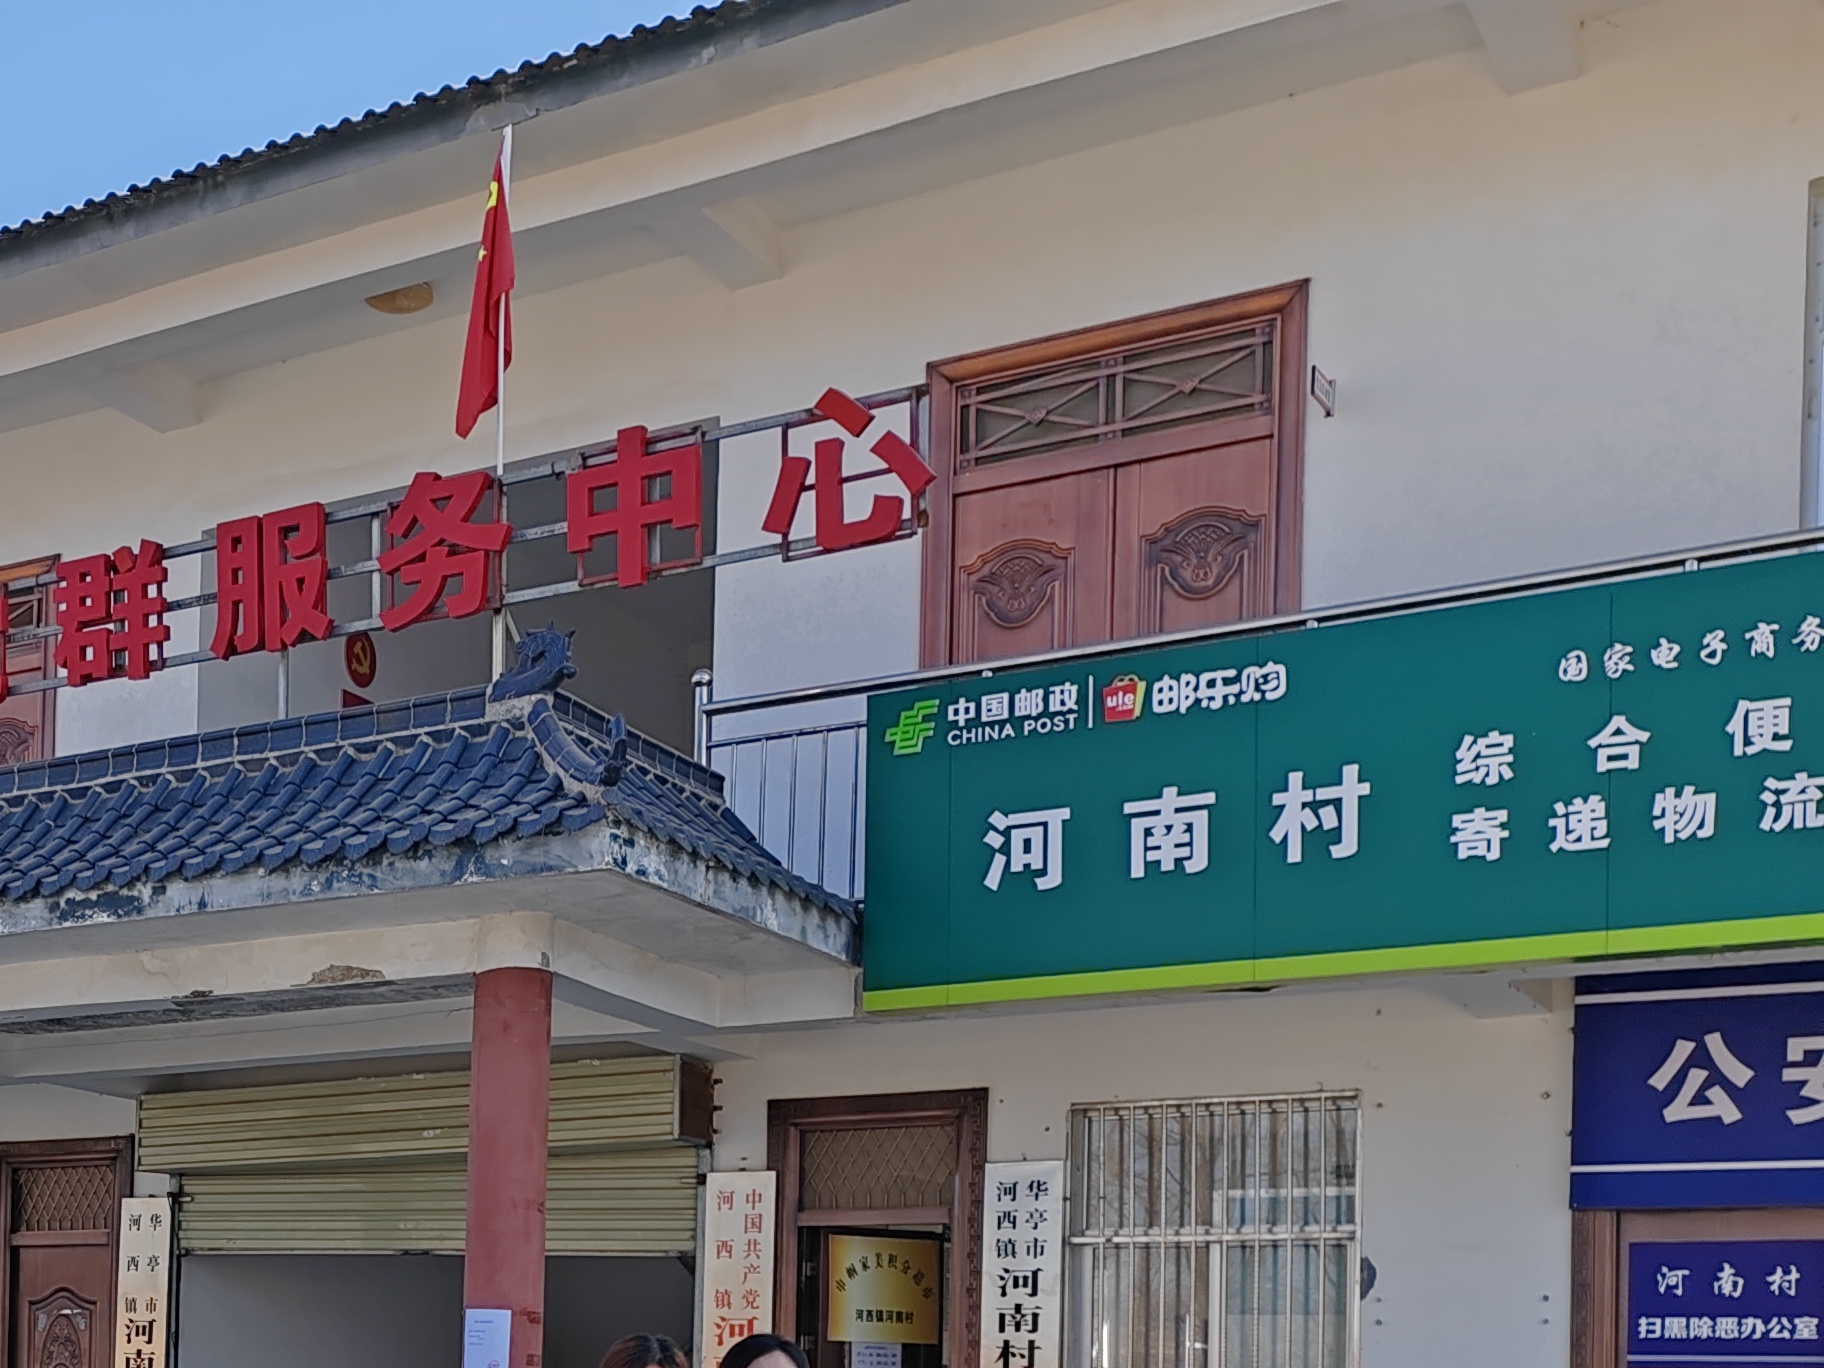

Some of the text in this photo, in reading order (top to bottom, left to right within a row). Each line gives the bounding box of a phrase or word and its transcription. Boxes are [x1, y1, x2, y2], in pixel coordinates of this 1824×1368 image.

[1152, 662, 1287, 714] 邮乐购
[1558, 615, 1824, 682] 国家电子商务
[947, 682, 1078, 727] 中国邮政
[947, 714, 1078, 745] CHINA POST
[1107, 690, 1135, 707] ule
[1454, 697, 1793, 786] 综合便
[982, 763, 1371, 891] 河南村
[1450, 772, 1824, 862] 寄递物流
[714, 1190, 736, 1310] 河西镇
[742, 1188, 764, 1311] 中国共产党
[994, 1181, 1020, 1260] 河西镇
[1023, 1180, 1049, 1259] 华亭市
[124, 1213, 143, 1314] 河西镇
[144, 1212, 162, 1315] 华亭市
[1656, 1262, 1801, 1298] 河南村
[855, 1308, 914, 1325] 河西镇河南村
[1638, 1315, 1819, 1341] 扫黑除恶办公室
